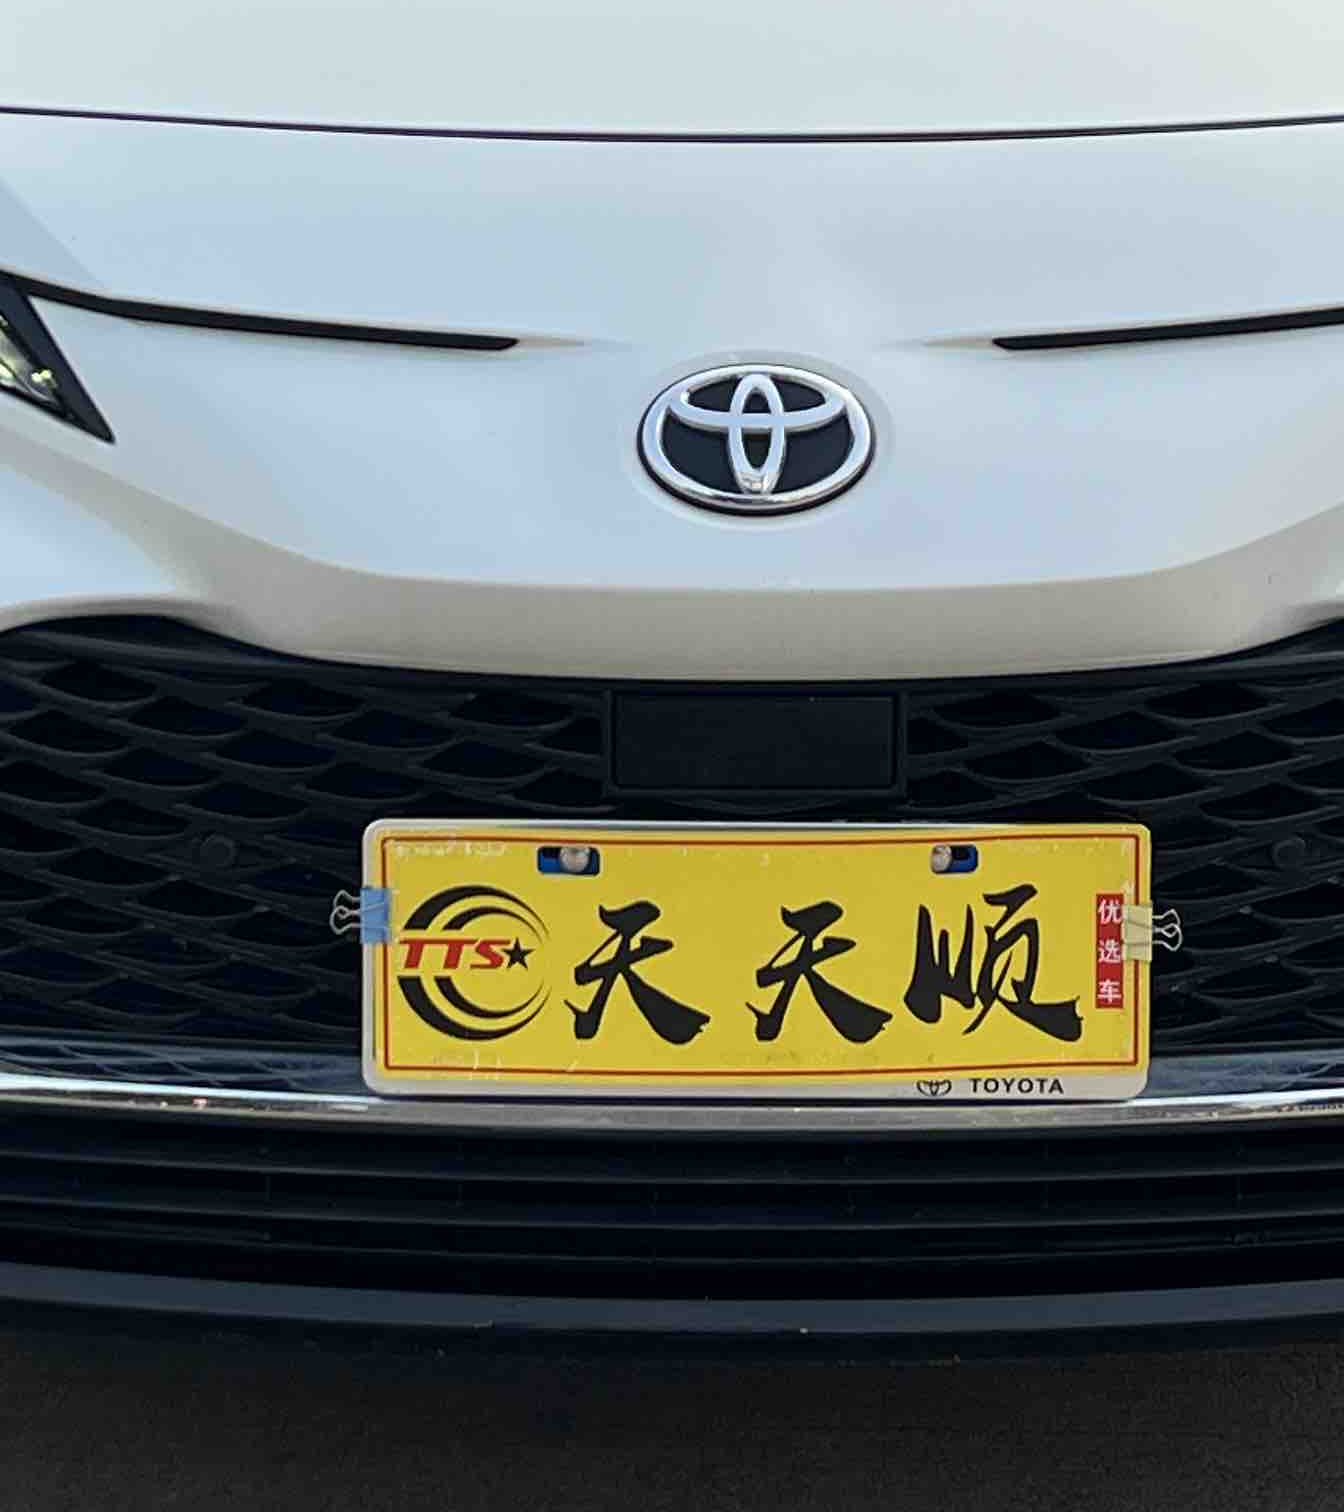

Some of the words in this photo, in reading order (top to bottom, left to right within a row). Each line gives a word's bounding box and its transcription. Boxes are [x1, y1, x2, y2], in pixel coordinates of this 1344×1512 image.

[399, 939, 511, 970] TTS
[564, 884, 1082, 1045] 天天顺
[1096, 897, 1123, 1004] 优选车
[968, 1077, 1064, 1095] TOYOTA
